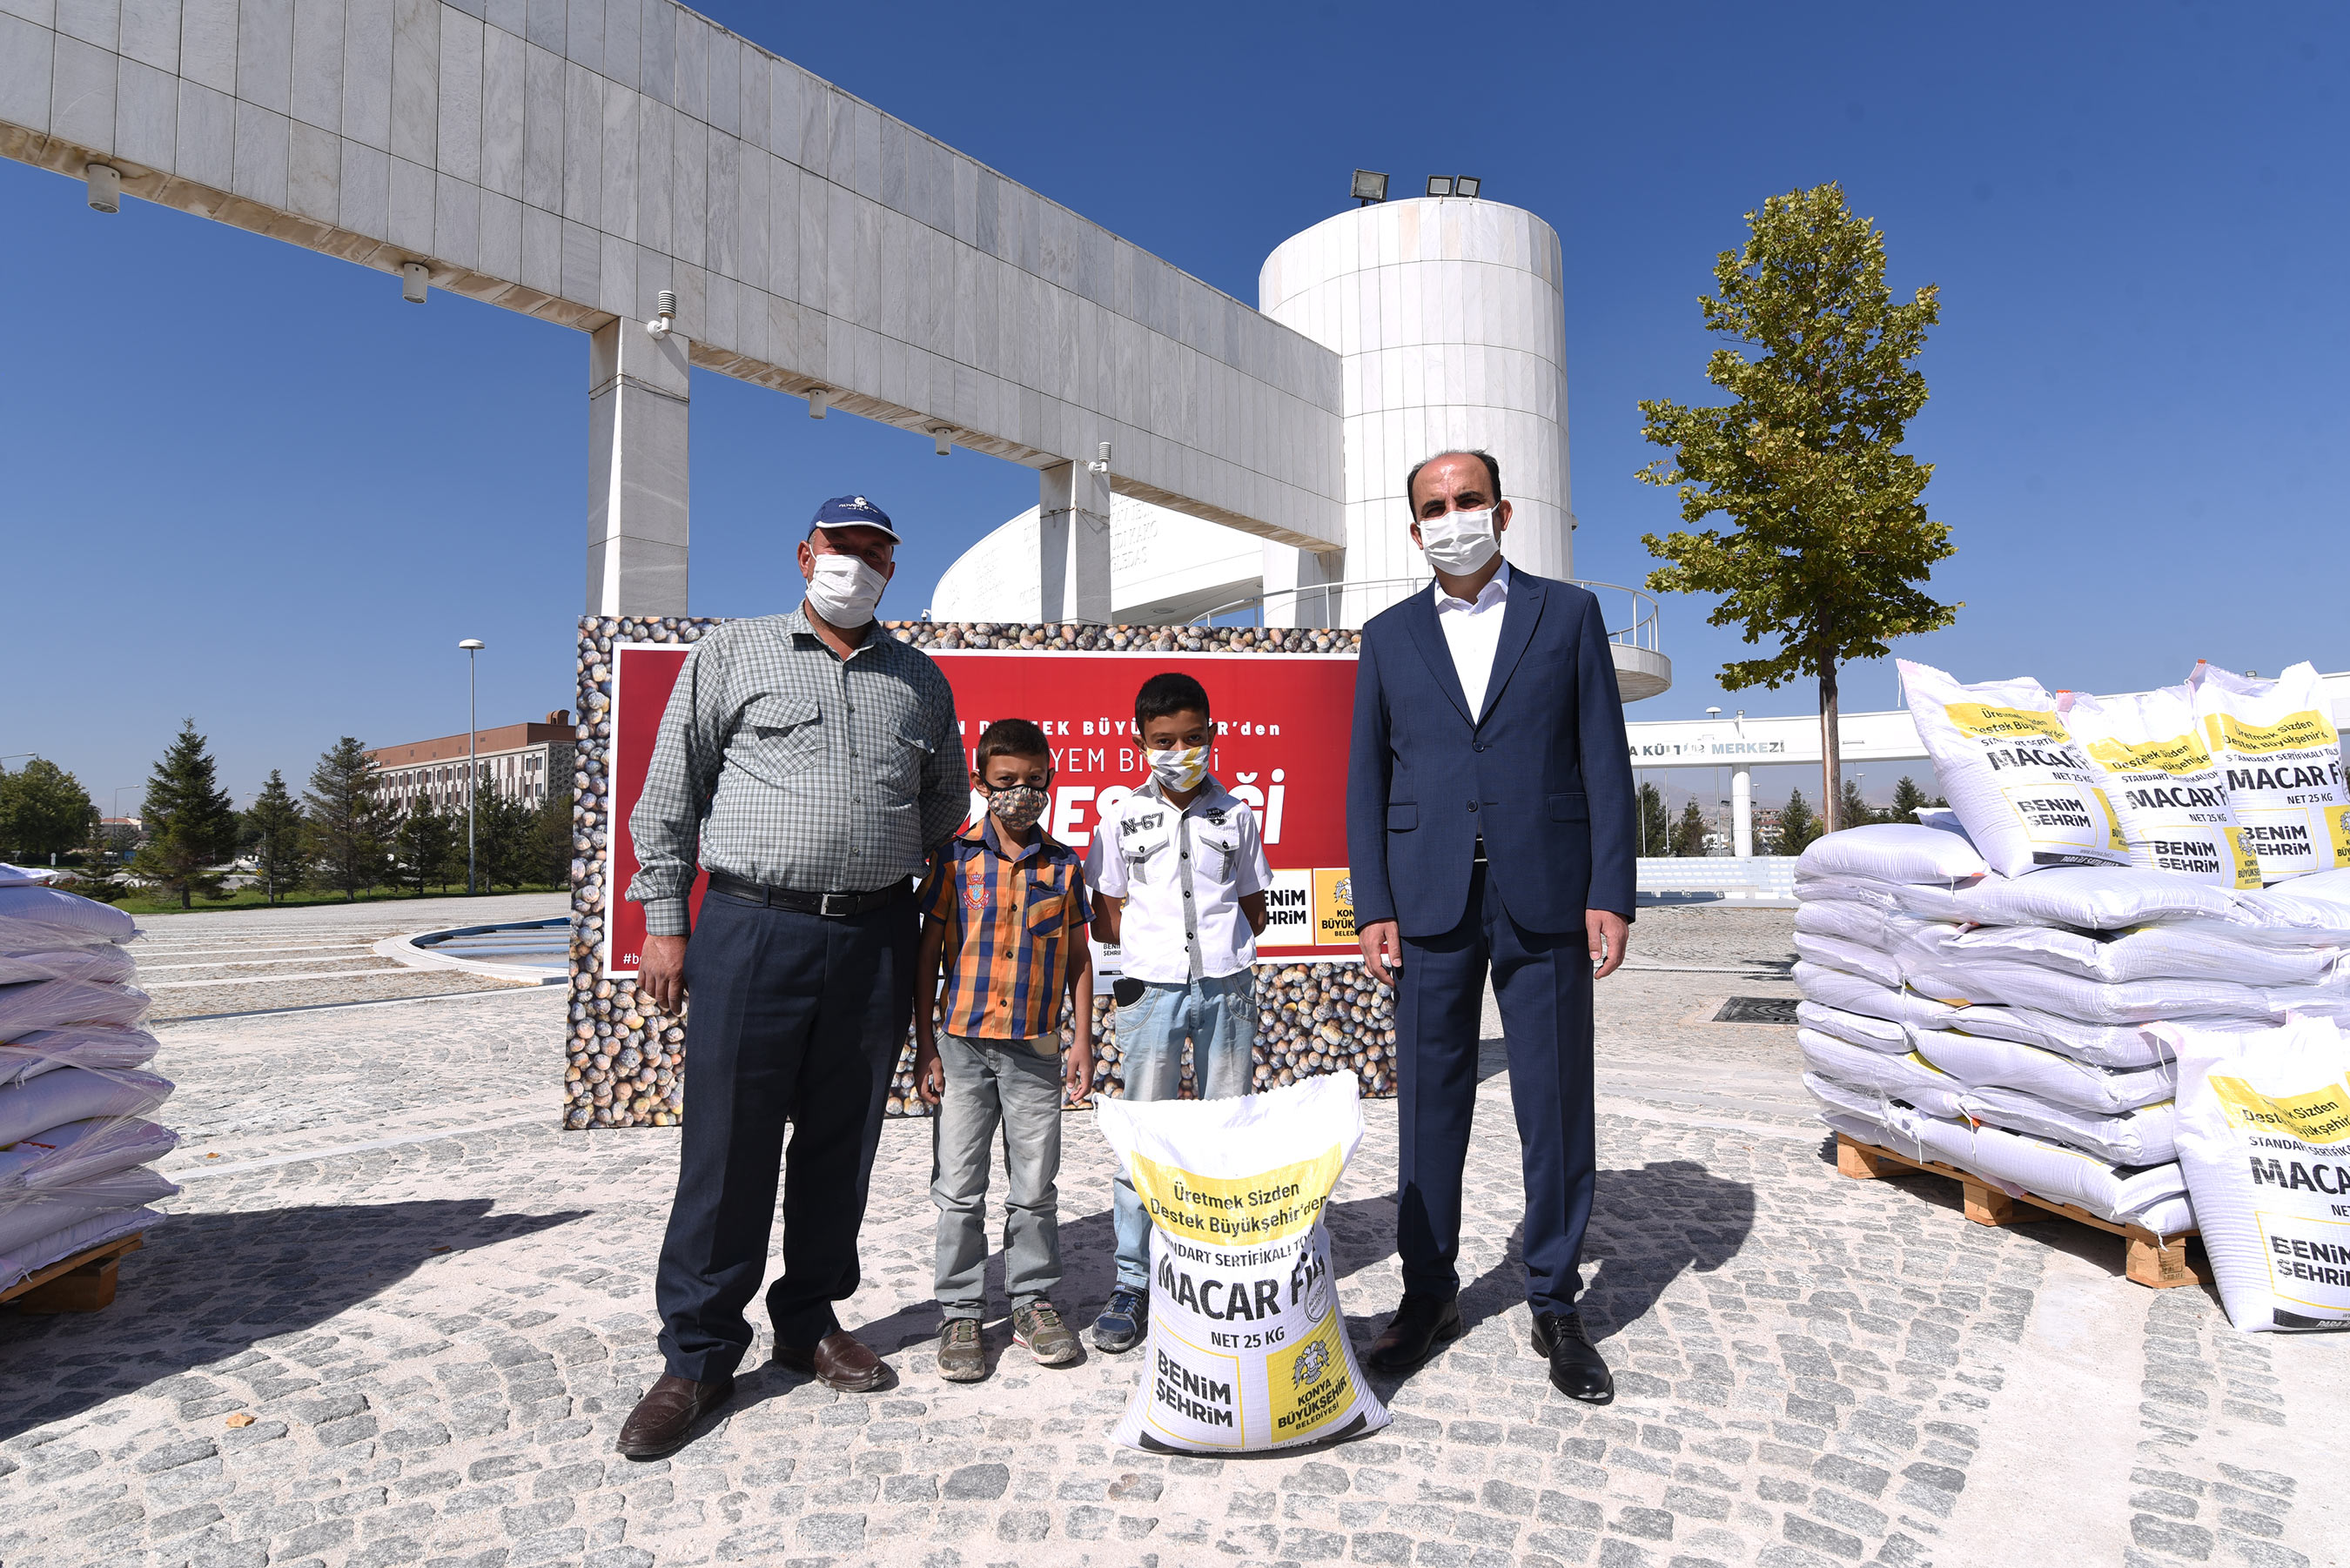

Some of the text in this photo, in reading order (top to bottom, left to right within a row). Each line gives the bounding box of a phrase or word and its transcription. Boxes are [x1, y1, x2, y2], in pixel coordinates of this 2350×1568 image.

[2277, 720, 2314, 733] Sizden
[1049, 747, 1105, 773] YEM
[2052, 771, 2071, 781] NET
[2071, 774, 2084, 782] 25
[2226, 765, 2328, 791] MACAR
[2125, 787, 2219, 810] MACAR
[2286, 792, 2333, 805] NET 25 KG
[1120, 811, 1165, 837] N-67
[2189, 813, 2228, 822] NET 25 KG
[2252, 842, 2313, 856] EHRiM
[1321, 917, 1354, 929] BÜYÜK
[1336, 909, 1354, 918] KON
[2242, 1109, 2282, 1124] Dest
[2293, 1101, 2340, 1120] Sizden
[1174, 1181, 1299, 1210] Üretmek Sizden
[1150, 1197, 1205, 1231] Destek
[1158, 1252, 1282, 1322] MACAR
[1211, 1328, 1286, 1349] NET 25 KG
[1278, 1376, 1347, 1429] BÜYÜKŞEHİR
[1297, 1378, 1333, 1407] KONYA
[1295, 1398, 1340, 1430] BELEDİYESİ
